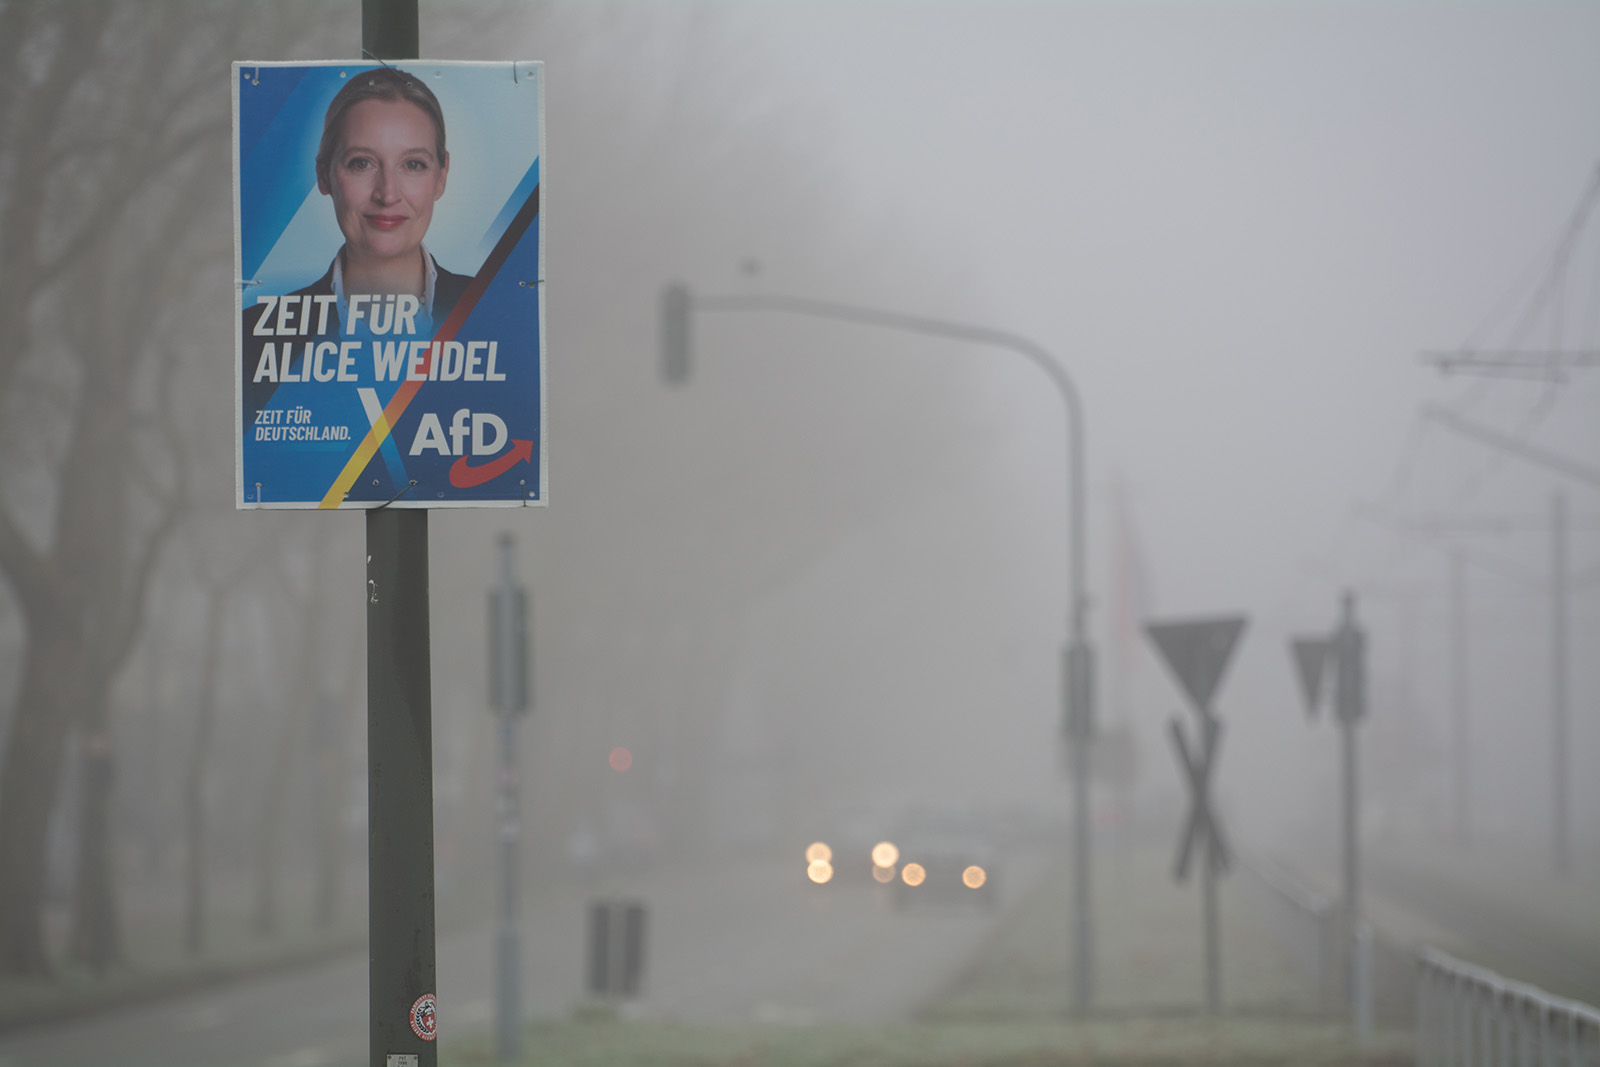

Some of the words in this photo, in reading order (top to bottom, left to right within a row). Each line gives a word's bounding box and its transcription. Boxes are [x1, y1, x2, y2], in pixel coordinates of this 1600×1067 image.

[253, 295, 338, 336] ZEIT
[252, 341, 361, 383] ALICE
[372, 341, 506, 382] WEIDEL
[254, 410, 284, 425] ZEIT
[286, 406, 312, 424] FÜR
[255, 426, 351, 441] DEUTSCHLAND.
[408, 408, 508, 456] AfD
